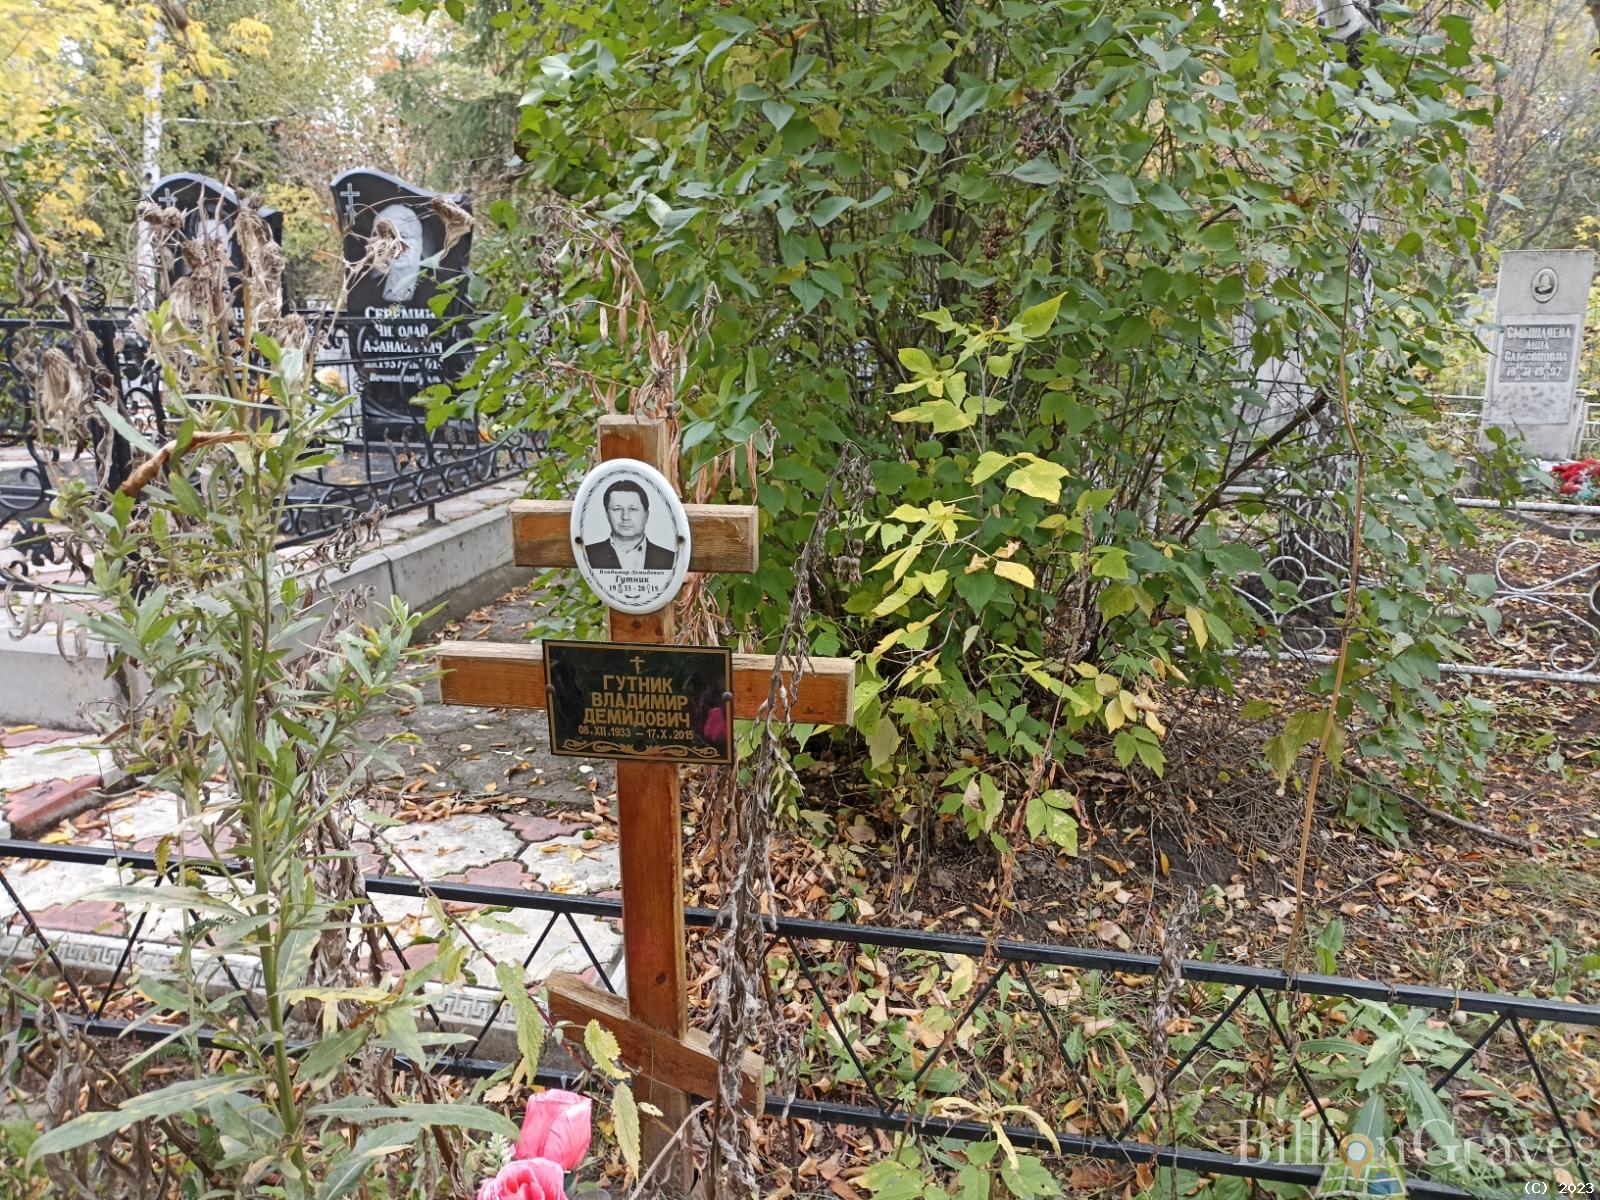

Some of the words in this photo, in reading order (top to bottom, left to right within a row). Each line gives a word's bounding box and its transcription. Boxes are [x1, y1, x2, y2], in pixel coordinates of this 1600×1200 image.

[615, 575, 649, 585] Гутник
[603, 674, 673, 693] ГУТНИК
[591, 692, 688, 711] ВЛАДИМИР
[583, 708, 690, 728] ДЕМИДОВИЧ
